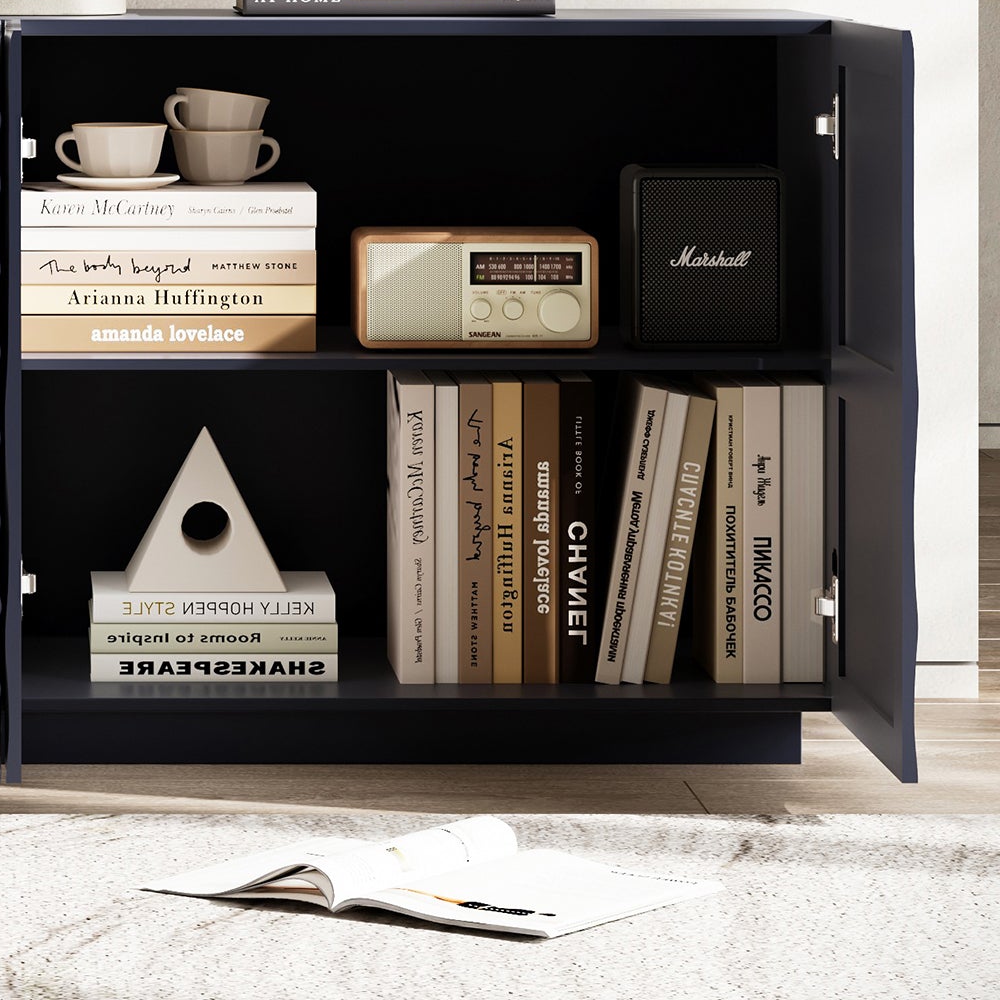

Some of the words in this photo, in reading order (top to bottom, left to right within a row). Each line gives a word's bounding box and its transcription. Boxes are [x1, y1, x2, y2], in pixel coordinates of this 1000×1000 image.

[40, 199, 86, 216] Karen
[92, 199, 175, 220] McCartney
[670, 245, 752, 267] Marshall
[39, 259, 77, 274] The
[83, 255, 122, 275] body
[131, 258, 191, 282] beyond
[68, 289, 145, 305] Arianna
[154, 289, 264, 310] Huffington
[91, 324, 163, 342] amanda
[170, 324, 244, 342] lovelace
[725, 505, 736, 593] ПОХИТИТЕЛЬ
[753, 536, 772, 622] ПИКАССО
[725, 597, 736, 658] БАБОЧЕК
